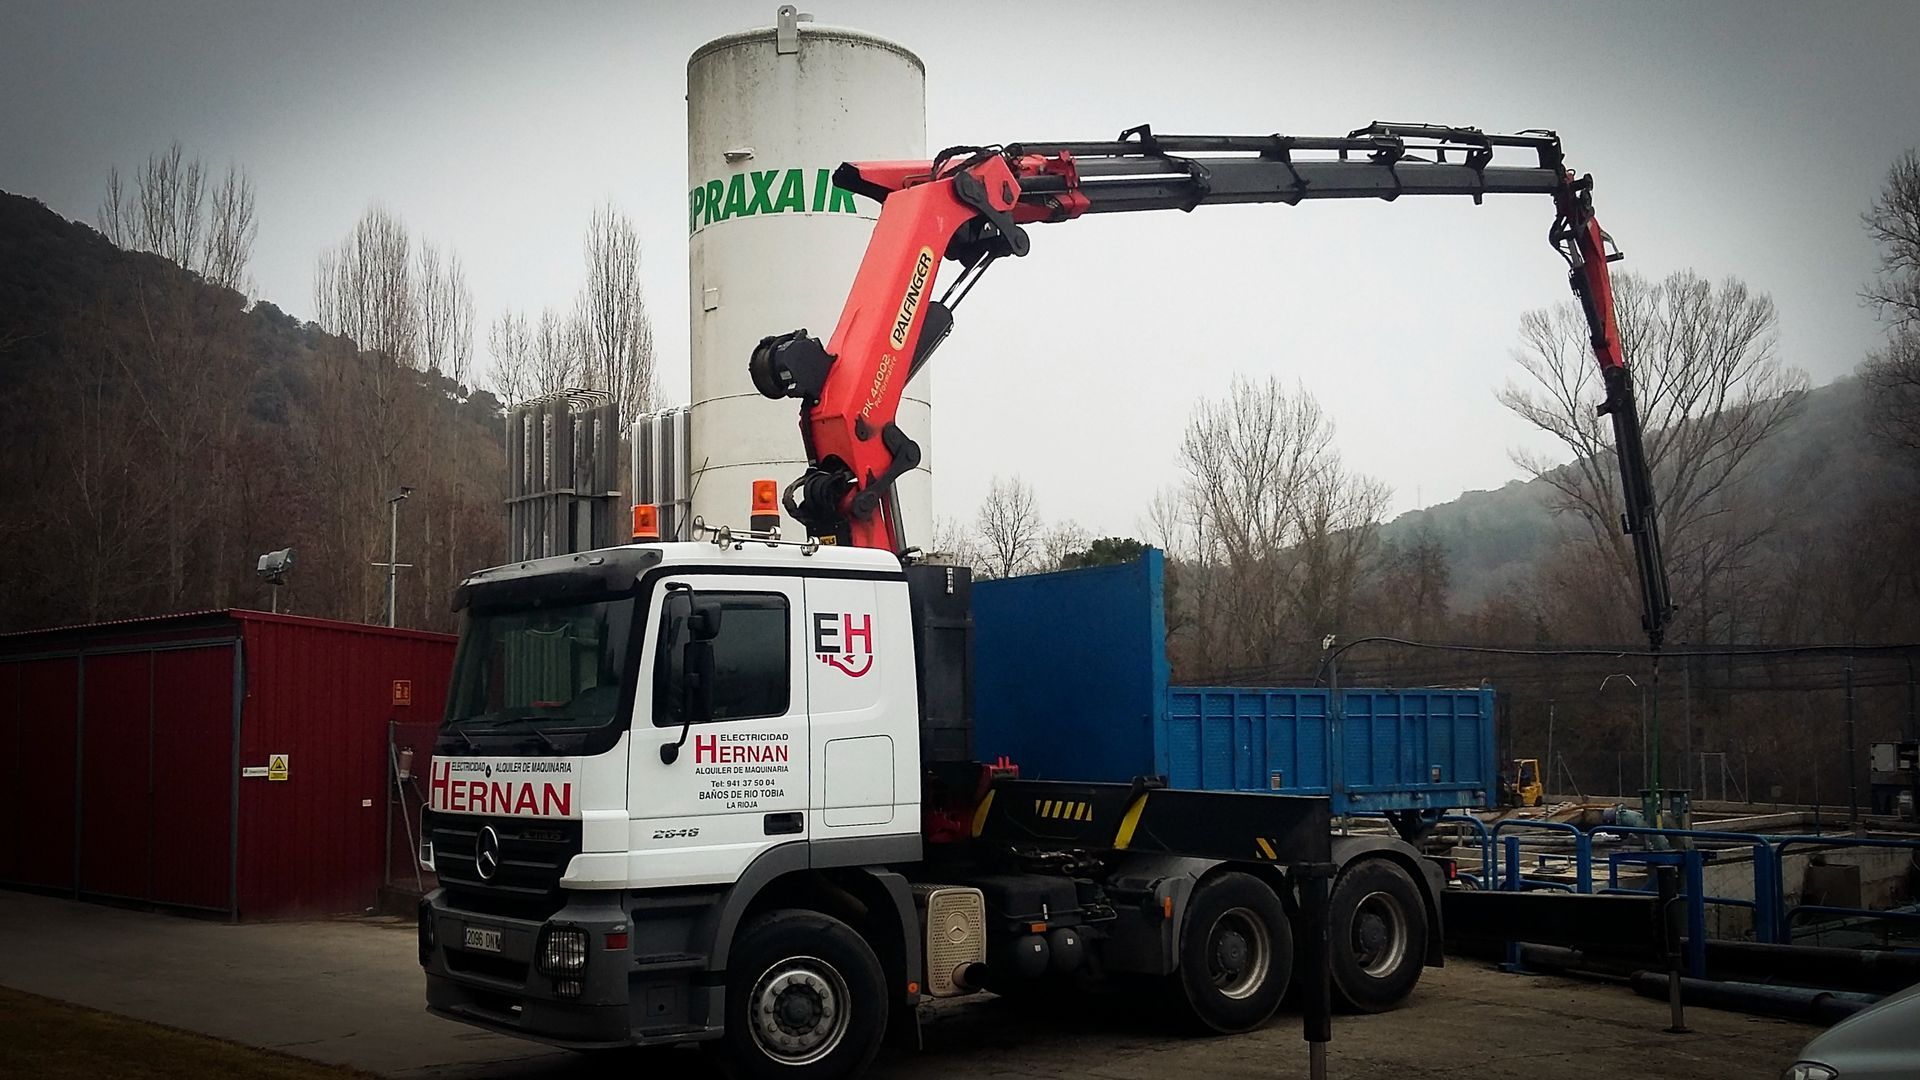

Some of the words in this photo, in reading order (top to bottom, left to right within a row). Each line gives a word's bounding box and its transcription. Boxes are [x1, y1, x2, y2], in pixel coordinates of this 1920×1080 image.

[892, 252, 932, 344] PALFINGER
[862, 398, 874, 418] PK
[870, 353, 891, 398] 44002
[813, 612, 872, 654] EH
[720, 734, 789, 742] ELECTRICIDAD
[695, 735, 788, 763] HERNAN
[451, 761, 485, 772] ELECTRICIDAD
[495, 762, 522, 773] ALQUILER
[522, 762, 531, 773] DE
[531, 762, 572, 773] MAQUINARIA
[695, 767, 732, 775] ALQUILER
[733, 766, 743, 774] DE
[744, 765, 789, 773] MAQUINARIA
[431, 761, 571, 816] HERNAN
[699, 789, 729, 800] BAÑOS
[731, 791, 741, 799] DE
[744, 790, 758, 798] RIO
[760, 789, 784, 798] TOBIA
[652, 828, 700, 840] 2646
[467, 930, 484, 947] 2096
